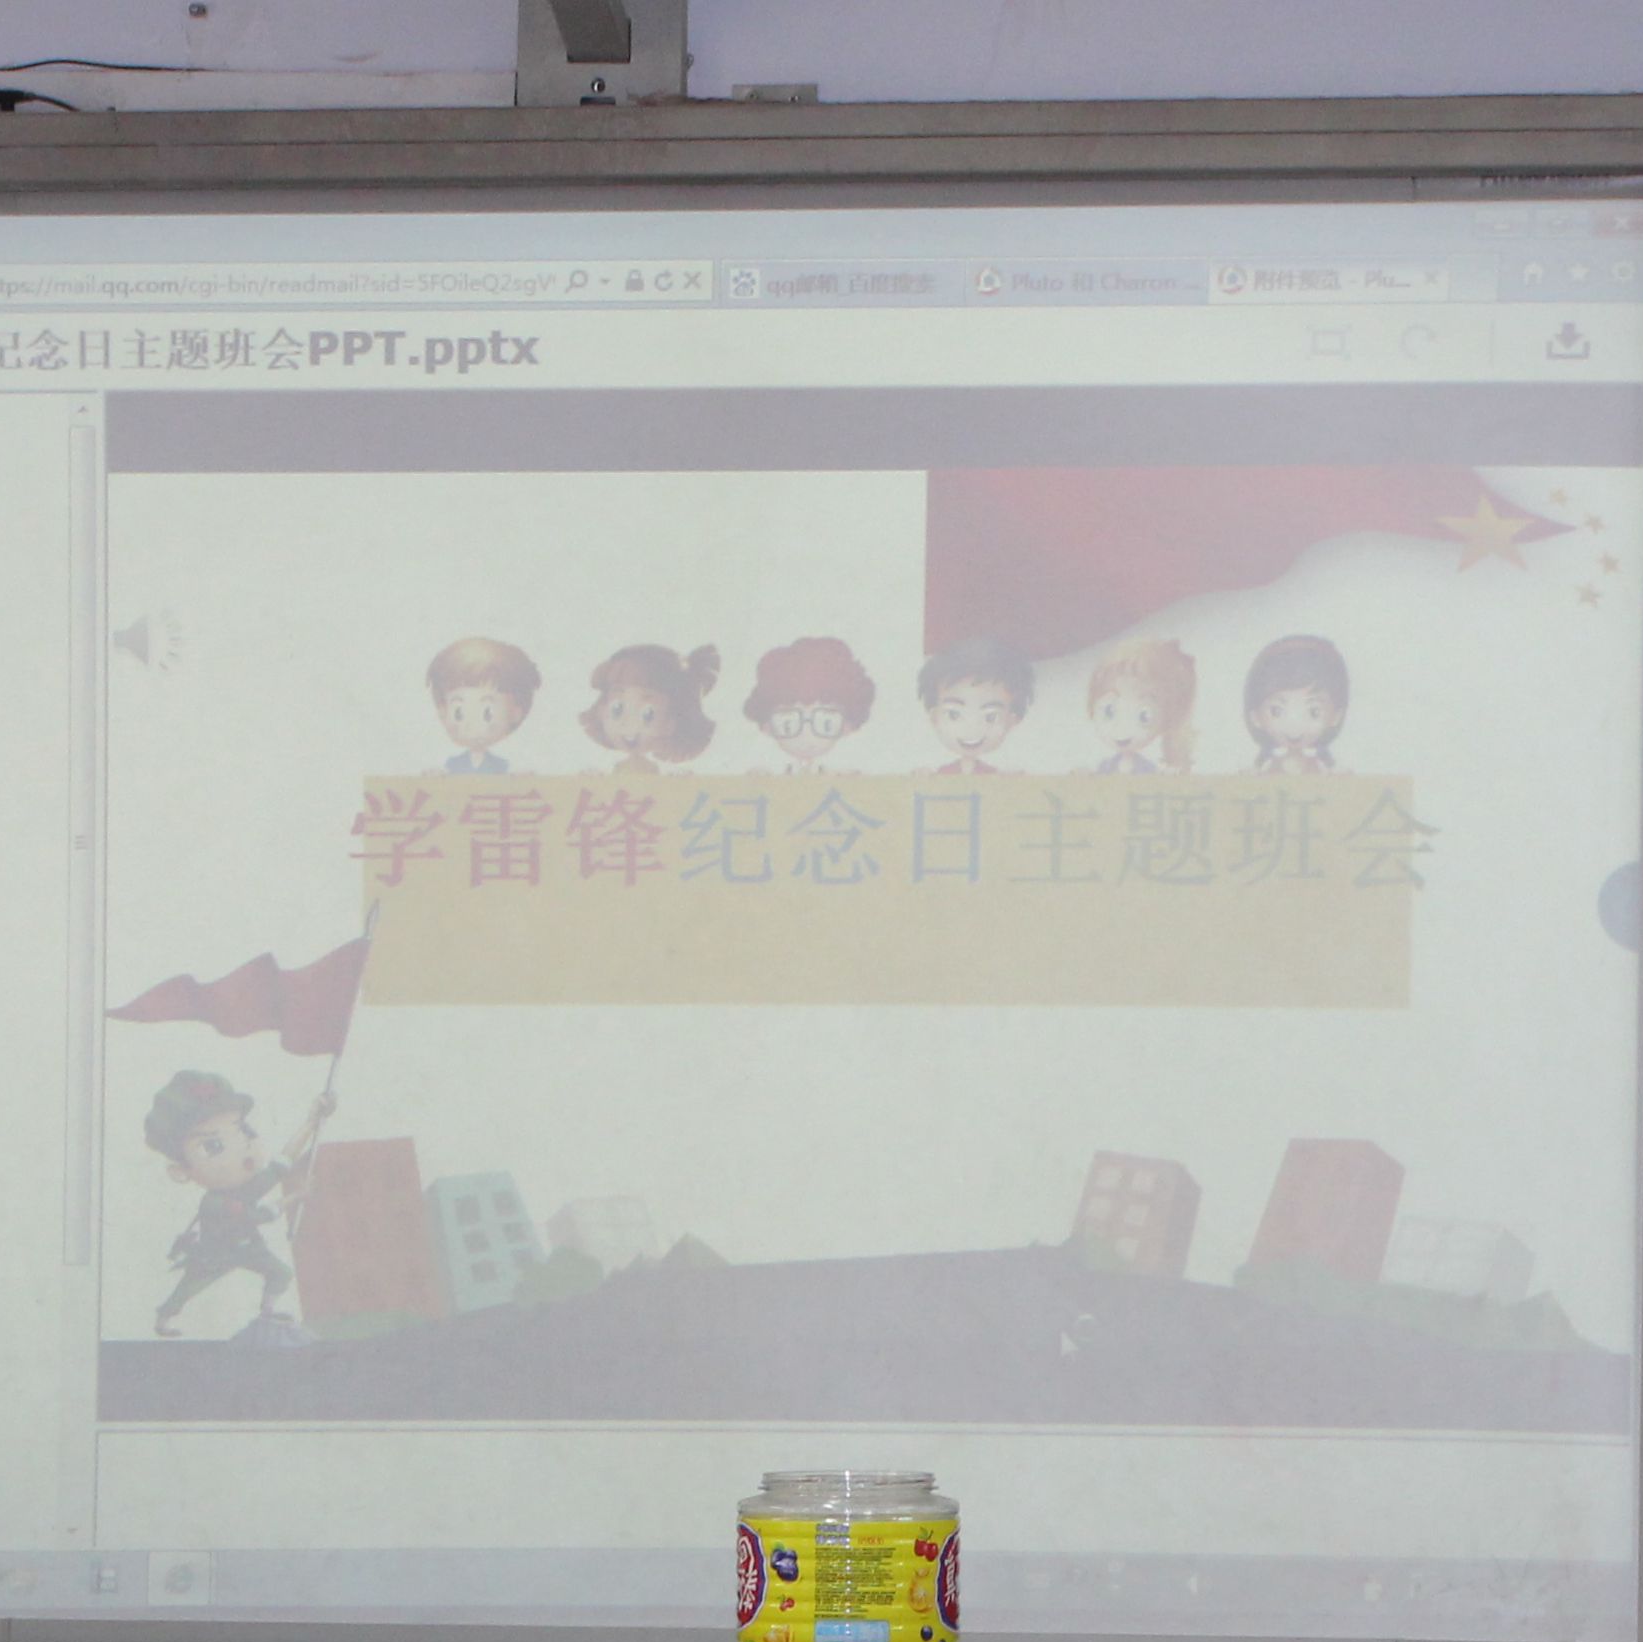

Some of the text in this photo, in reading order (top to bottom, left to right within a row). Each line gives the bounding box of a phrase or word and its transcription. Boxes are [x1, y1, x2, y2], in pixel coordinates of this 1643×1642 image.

[347, 785, 1443, 890] 学雷锋纪念日主题班会
